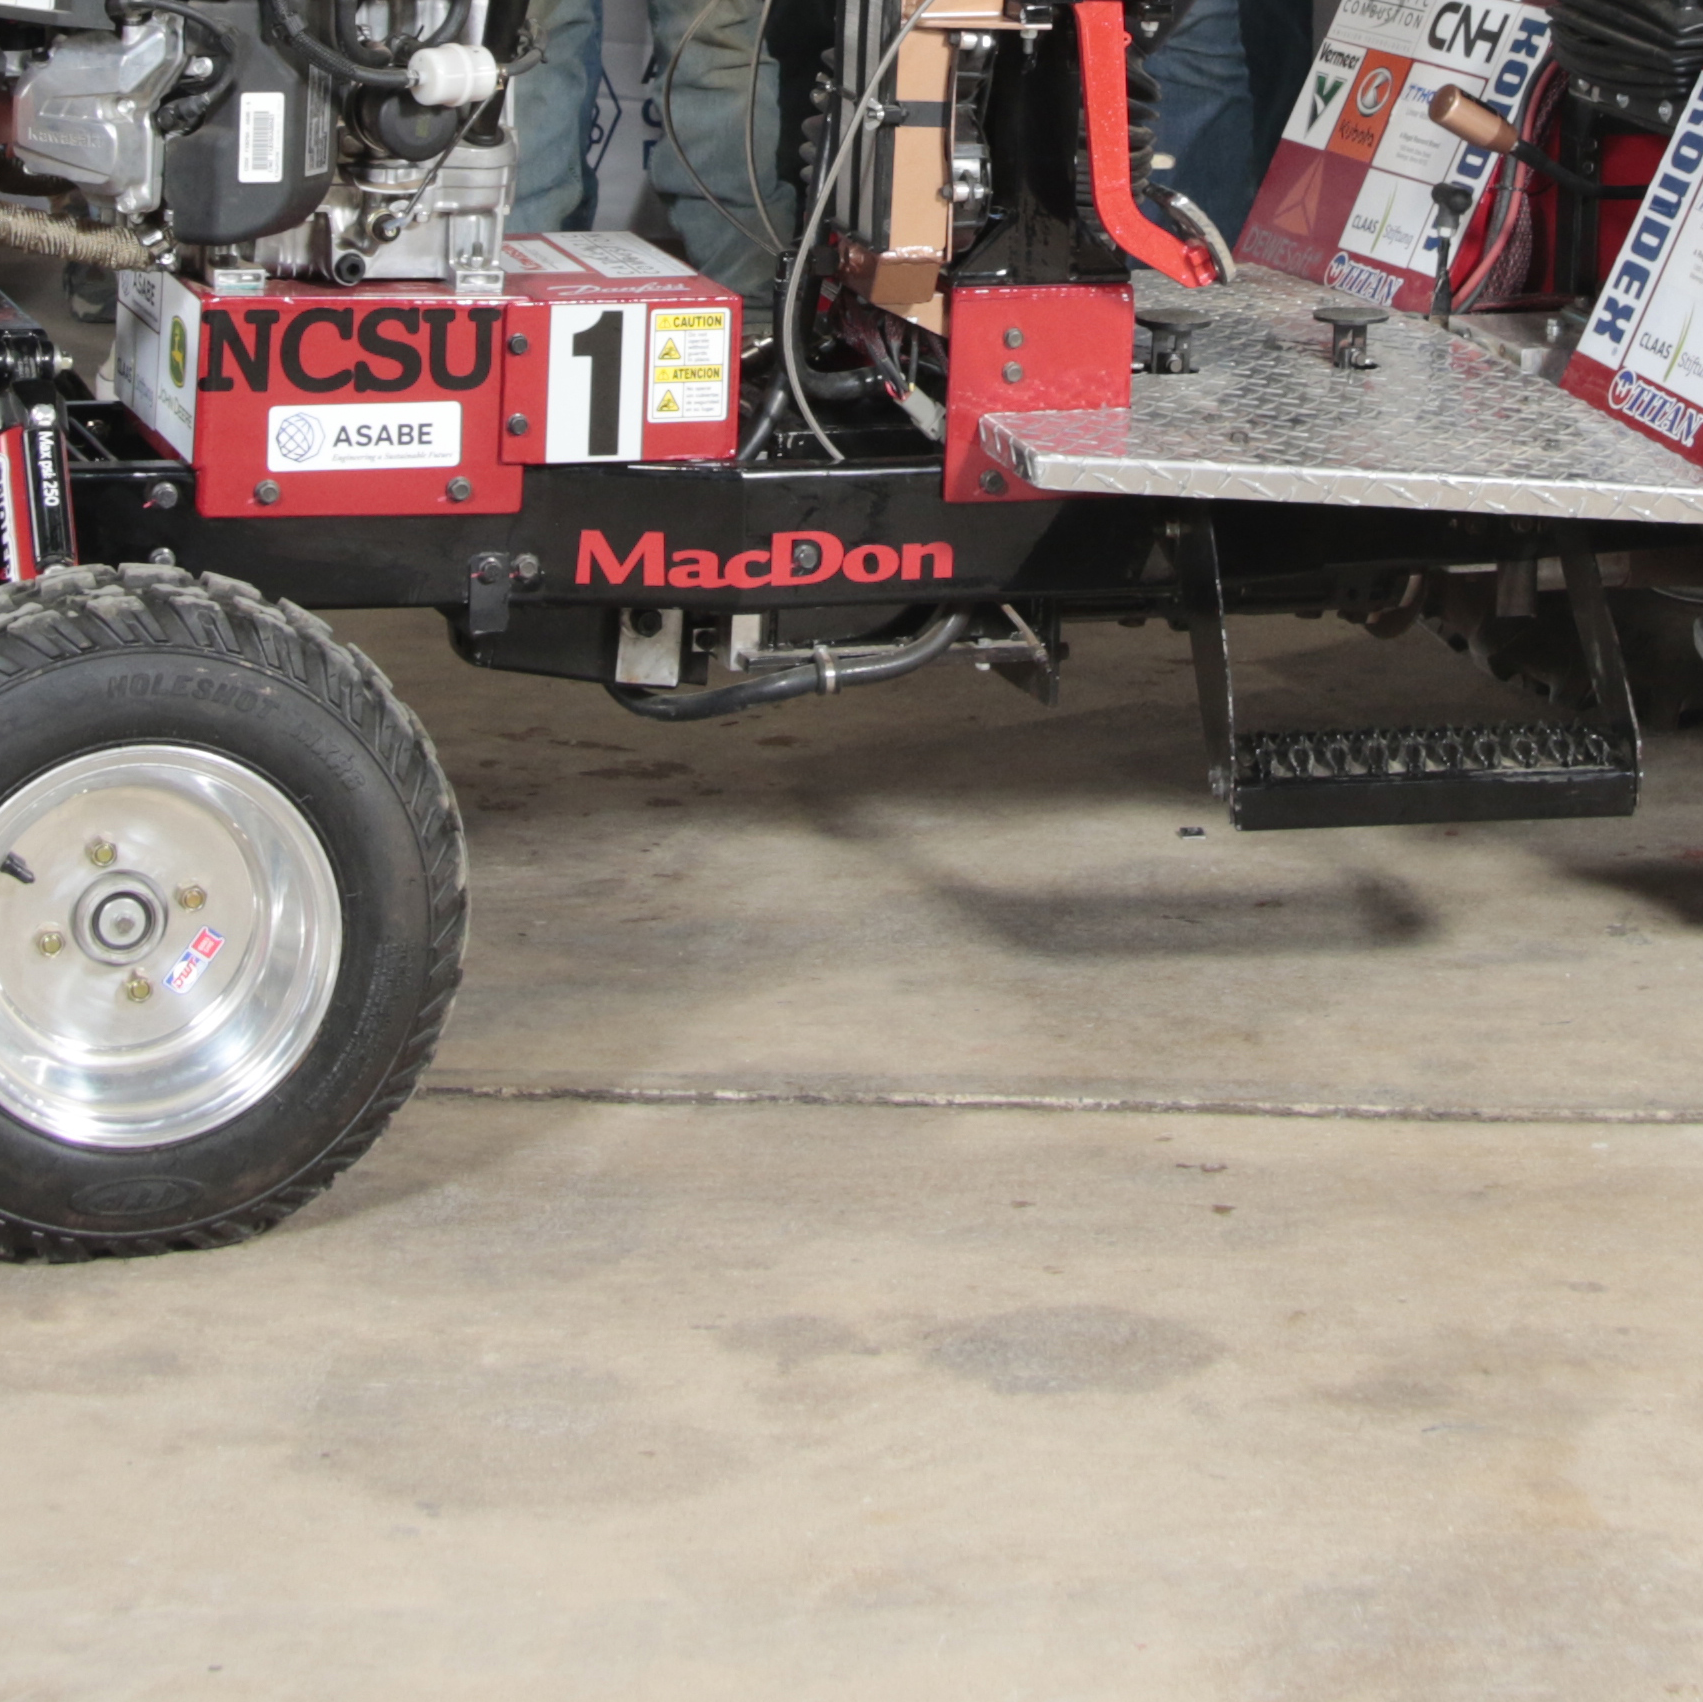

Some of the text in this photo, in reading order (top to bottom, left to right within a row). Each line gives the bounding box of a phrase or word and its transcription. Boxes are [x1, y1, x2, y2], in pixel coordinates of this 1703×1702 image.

[1427, 0, 1510, 64] CNH
[1319, 42, 1360, 70] Vermeer
[1351, 213, 1380, 235] CLAAS
[547, 282, 691, 297] Danfoss
[1341, 257, 1404, 305] TITAN
[673, 316, 723, 328] CAUTION
[199, 307, 502, 393] NCSU
[1639, 332, 1673, 360] CLAAS
[571, 311, 624, 457] 1
[672, 367, 720, 380] ATENCION
[38, 431, 53, 459] Max
[333, 423, 434, 448] ASABE
[42, 480, 60, 507] 250
[575, 530, 954, 588] MacDon
